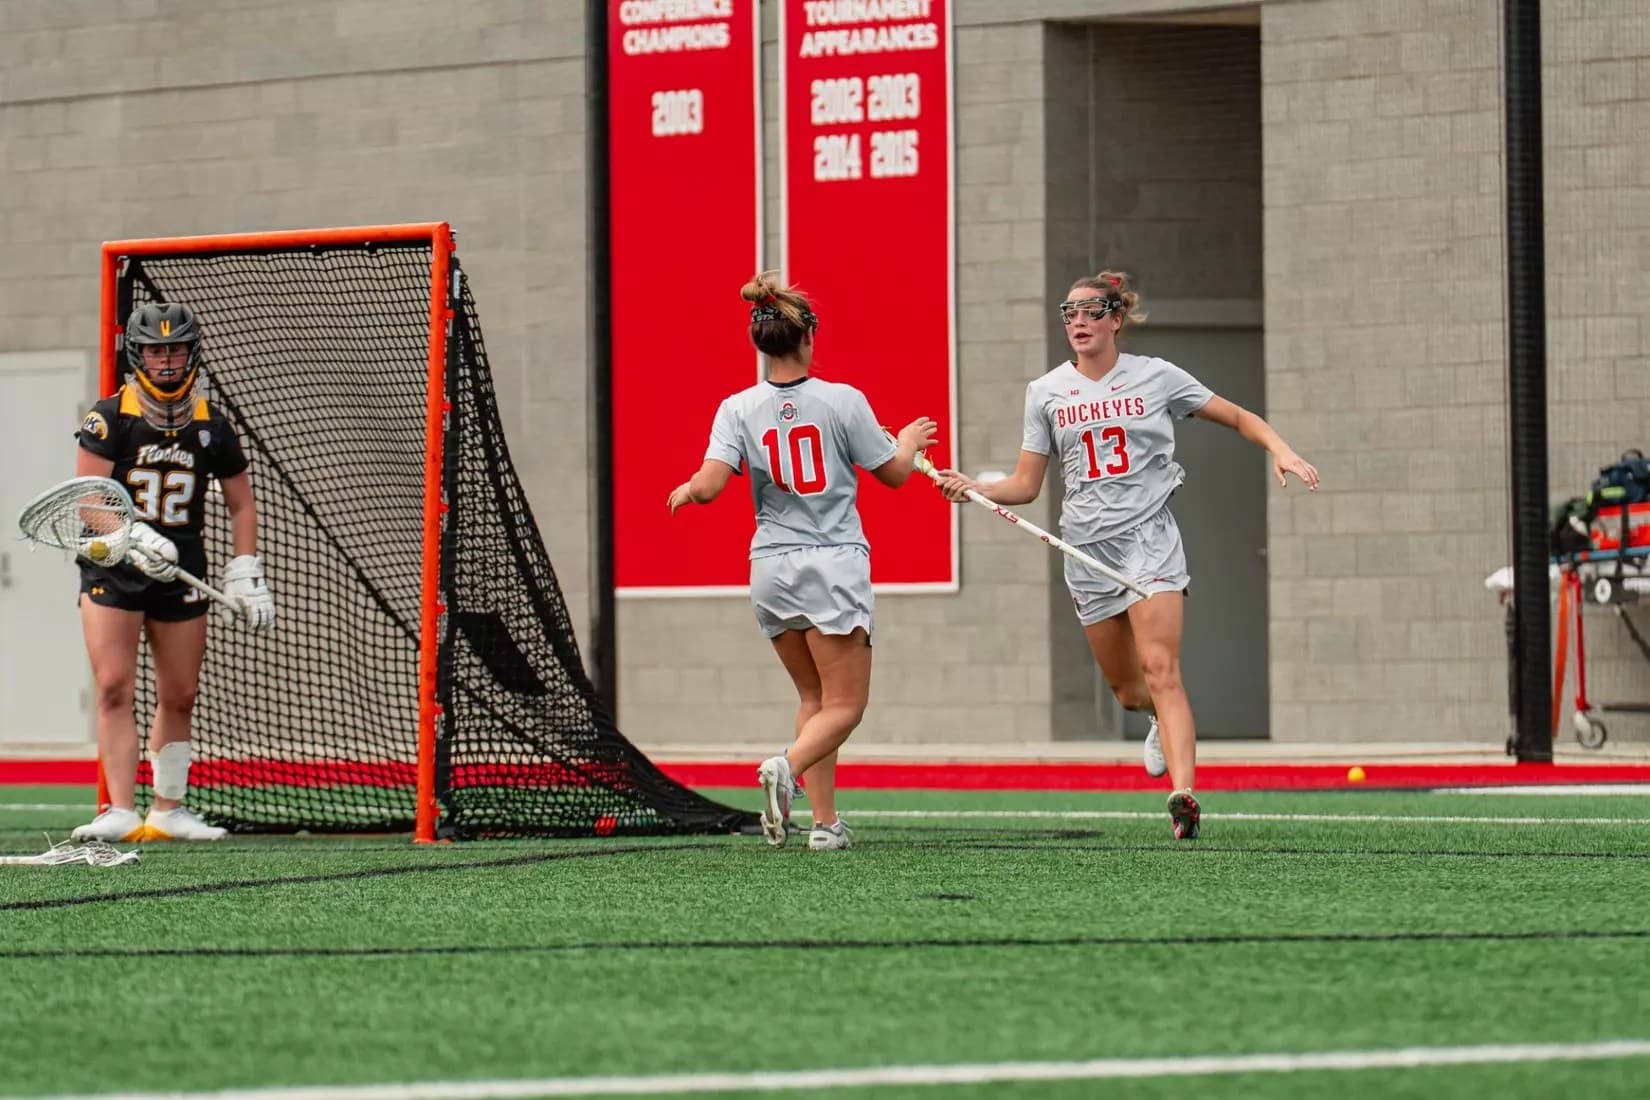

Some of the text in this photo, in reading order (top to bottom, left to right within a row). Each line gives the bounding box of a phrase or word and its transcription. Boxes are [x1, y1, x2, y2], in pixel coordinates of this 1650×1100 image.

[623, 22, 730, 55] CHAMPIONS
[800, 23, 938, 57] APPEARANCES
[652, 89, 704, 137] 2003
[811, 73, 920, 125] 2002 2003
[814, 130, 919, 181] 2014 2015
[1057, 397, 1145, 428] BUCKEYES
[136, 442, 194, 468] Flashes
[761, 424, 827, 496] 10
[1080, 425, 1131, 481] 13
[127, 468, 195, 526] 32
